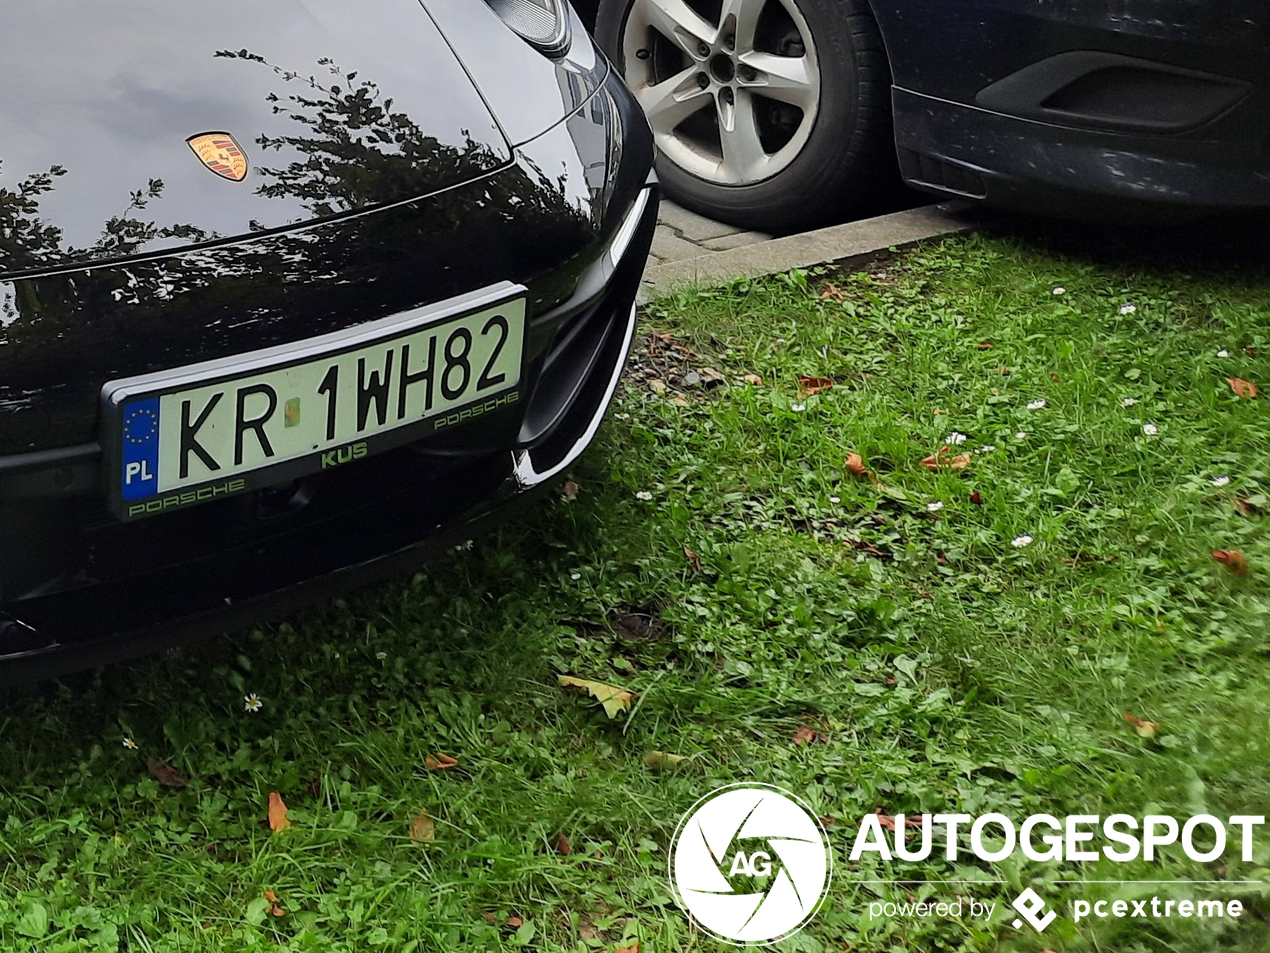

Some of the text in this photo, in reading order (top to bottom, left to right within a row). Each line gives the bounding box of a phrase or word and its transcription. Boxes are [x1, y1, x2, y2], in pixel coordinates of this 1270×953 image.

[179, 315, 510, 478] KR 1WH82
[434, 391, 520, 430] PORSCHE
[125, 459, 153, 485] PL
[321, 441, 368, 469] KUS
[128, 478, 245, 517] PORSCHE
